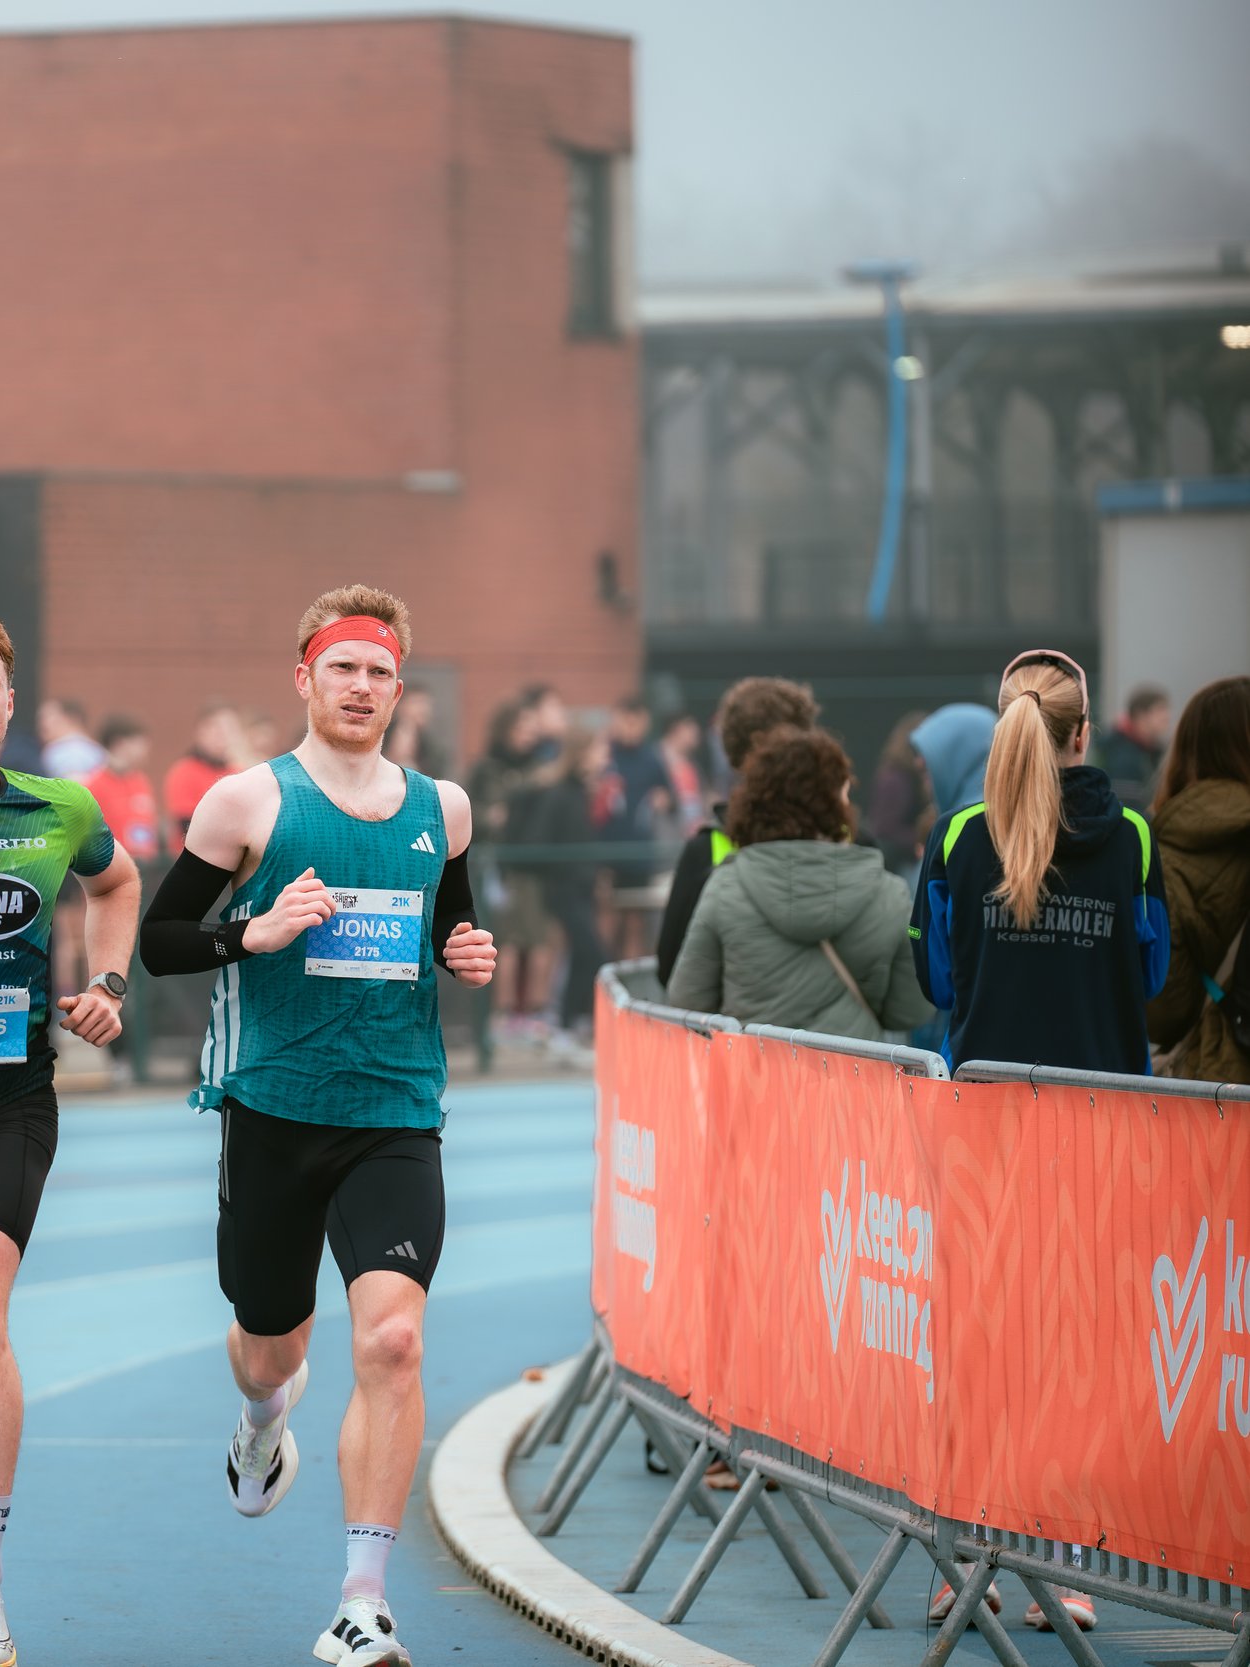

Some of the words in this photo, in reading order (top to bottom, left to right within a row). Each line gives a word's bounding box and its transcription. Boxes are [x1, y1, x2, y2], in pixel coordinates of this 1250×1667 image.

[391, 896, 410, 907] 21K
[332, 919, 402, 939] JONAS
[997, 931, 1056, 943] Kessel
[354, 946, 380, 957] 2175
[856, 1159, 908, 1281] keep
